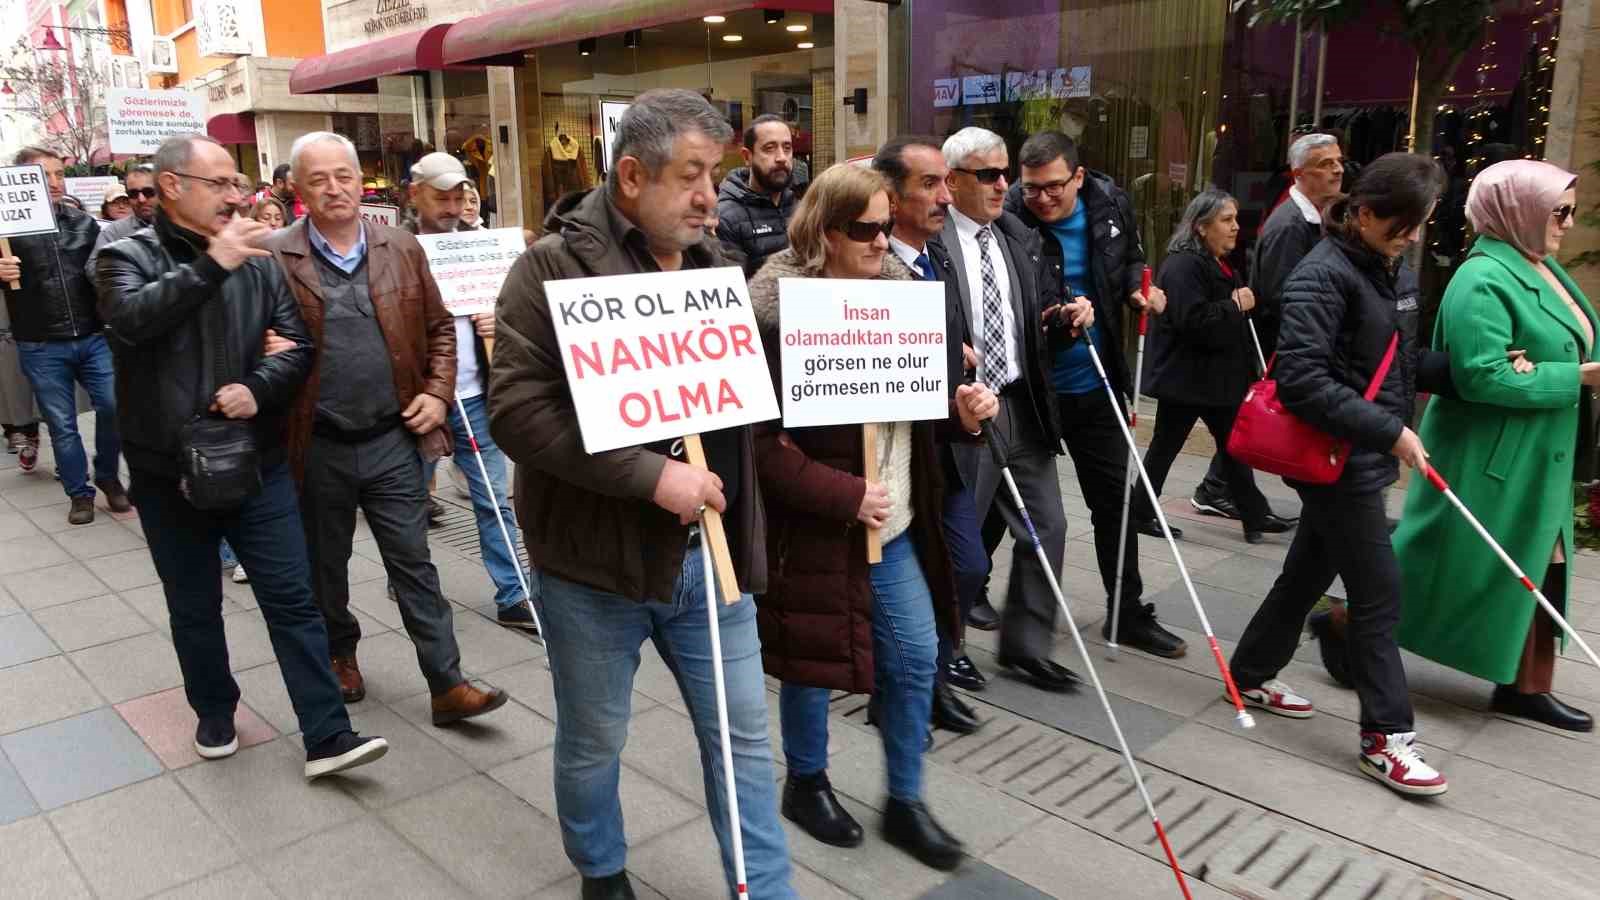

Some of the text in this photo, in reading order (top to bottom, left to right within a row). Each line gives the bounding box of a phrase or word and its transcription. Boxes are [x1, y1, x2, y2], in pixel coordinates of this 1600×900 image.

[124, 96, 187, 107] Gözlerimizle
[119, 109, 176, 118] göremesek
[146, 119, 163, 127] bize
[8, 191, 37, 203] ELDE
[1, 208, 32, 222] UZAT
[436, 238, 499, 251] Gözlerimiz
[559, 287, 742, 326] KÖR OL AMA
[843, 299, 890, 321] İnsan
[785, 328, 944, 346] olamadıktan sonra
[569, 319, 757, 379] NANKÖR
[804, 352, 929, 376] görsen ne olur
[791, 376, 942, 402] görmesen ne olur
[619, 378, 744, 428] OLMA
